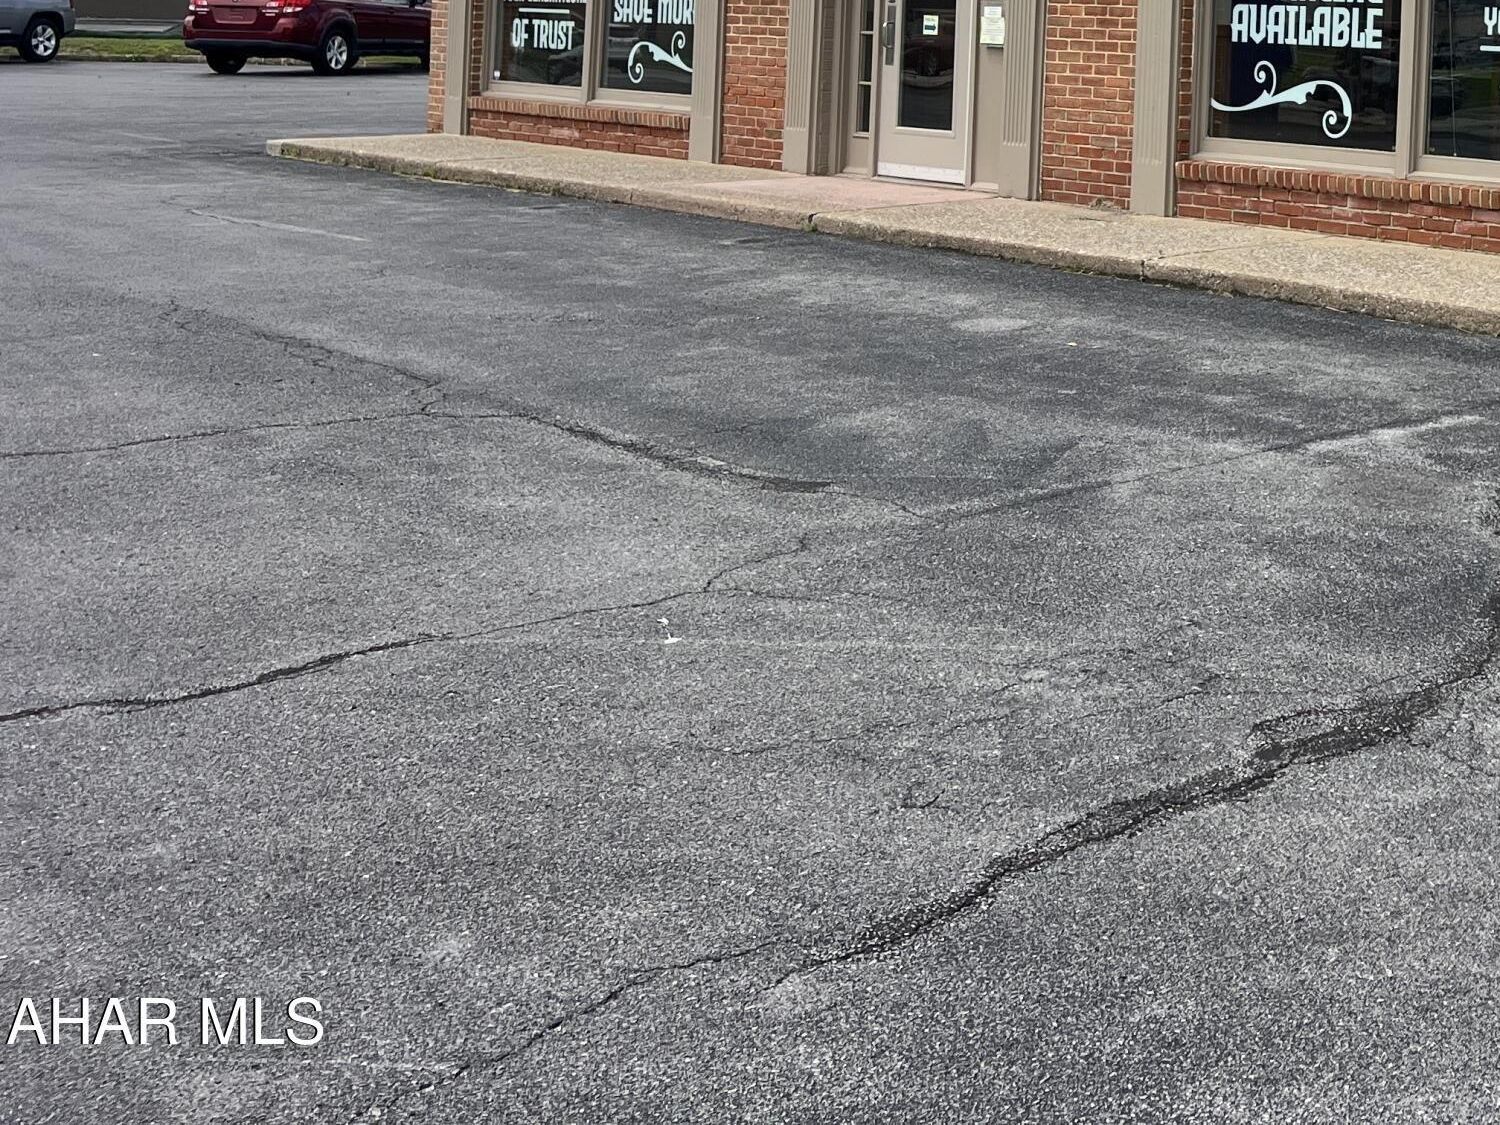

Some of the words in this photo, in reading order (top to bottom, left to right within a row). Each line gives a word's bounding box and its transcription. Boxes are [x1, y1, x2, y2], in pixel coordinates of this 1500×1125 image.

[512, 17, 529, 48] OF
[532, 19, 575, 51] TRUST
[1230, 3, 1384, 50] AVAILABLE
